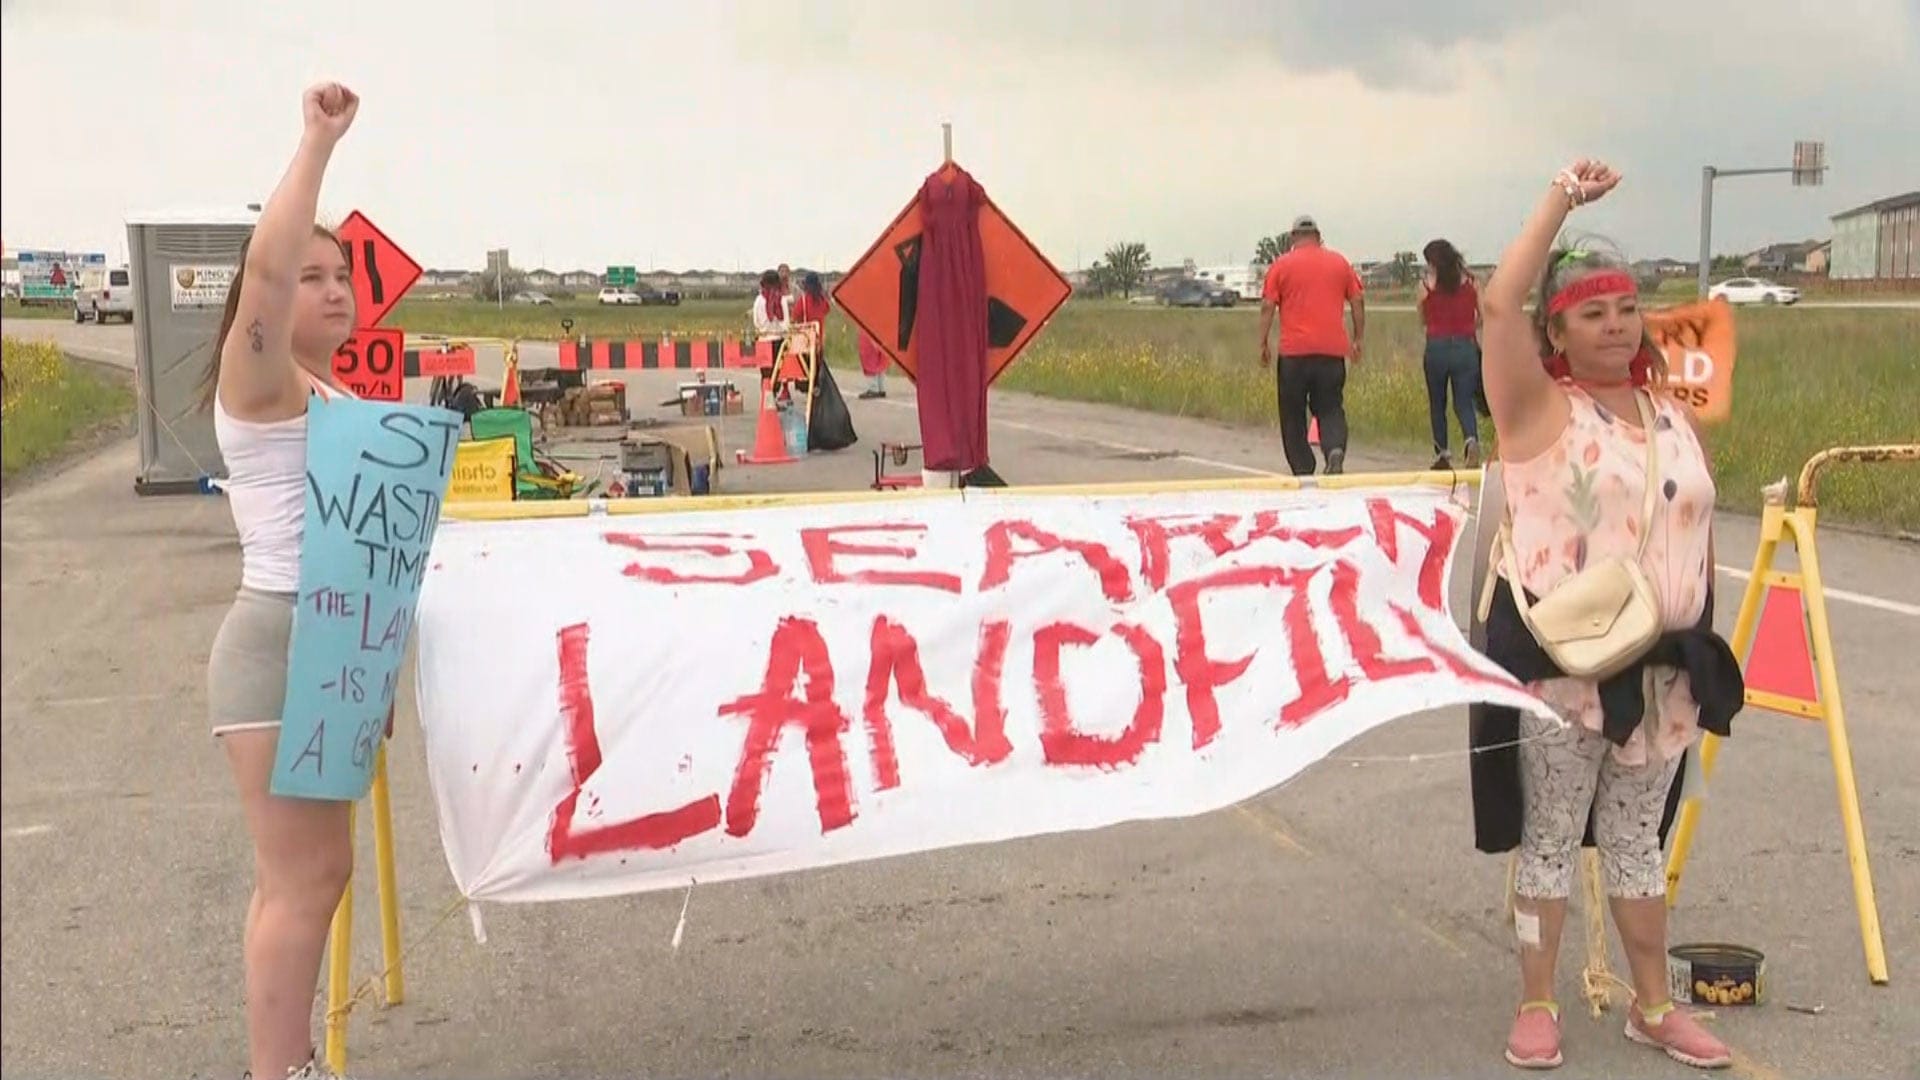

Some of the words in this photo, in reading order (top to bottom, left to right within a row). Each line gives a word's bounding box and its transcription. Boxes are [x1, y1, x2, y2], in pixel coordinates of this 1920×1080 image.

[336, 338, 394, 375] 50
[351, 381, 391, 396] m/h
[604, 498, 1461, 612] SEARCH
[304, 586, 355, 617] THE
[545, 560, 1545, 866] LANDFILL
[290, 719, 325, 777] A
